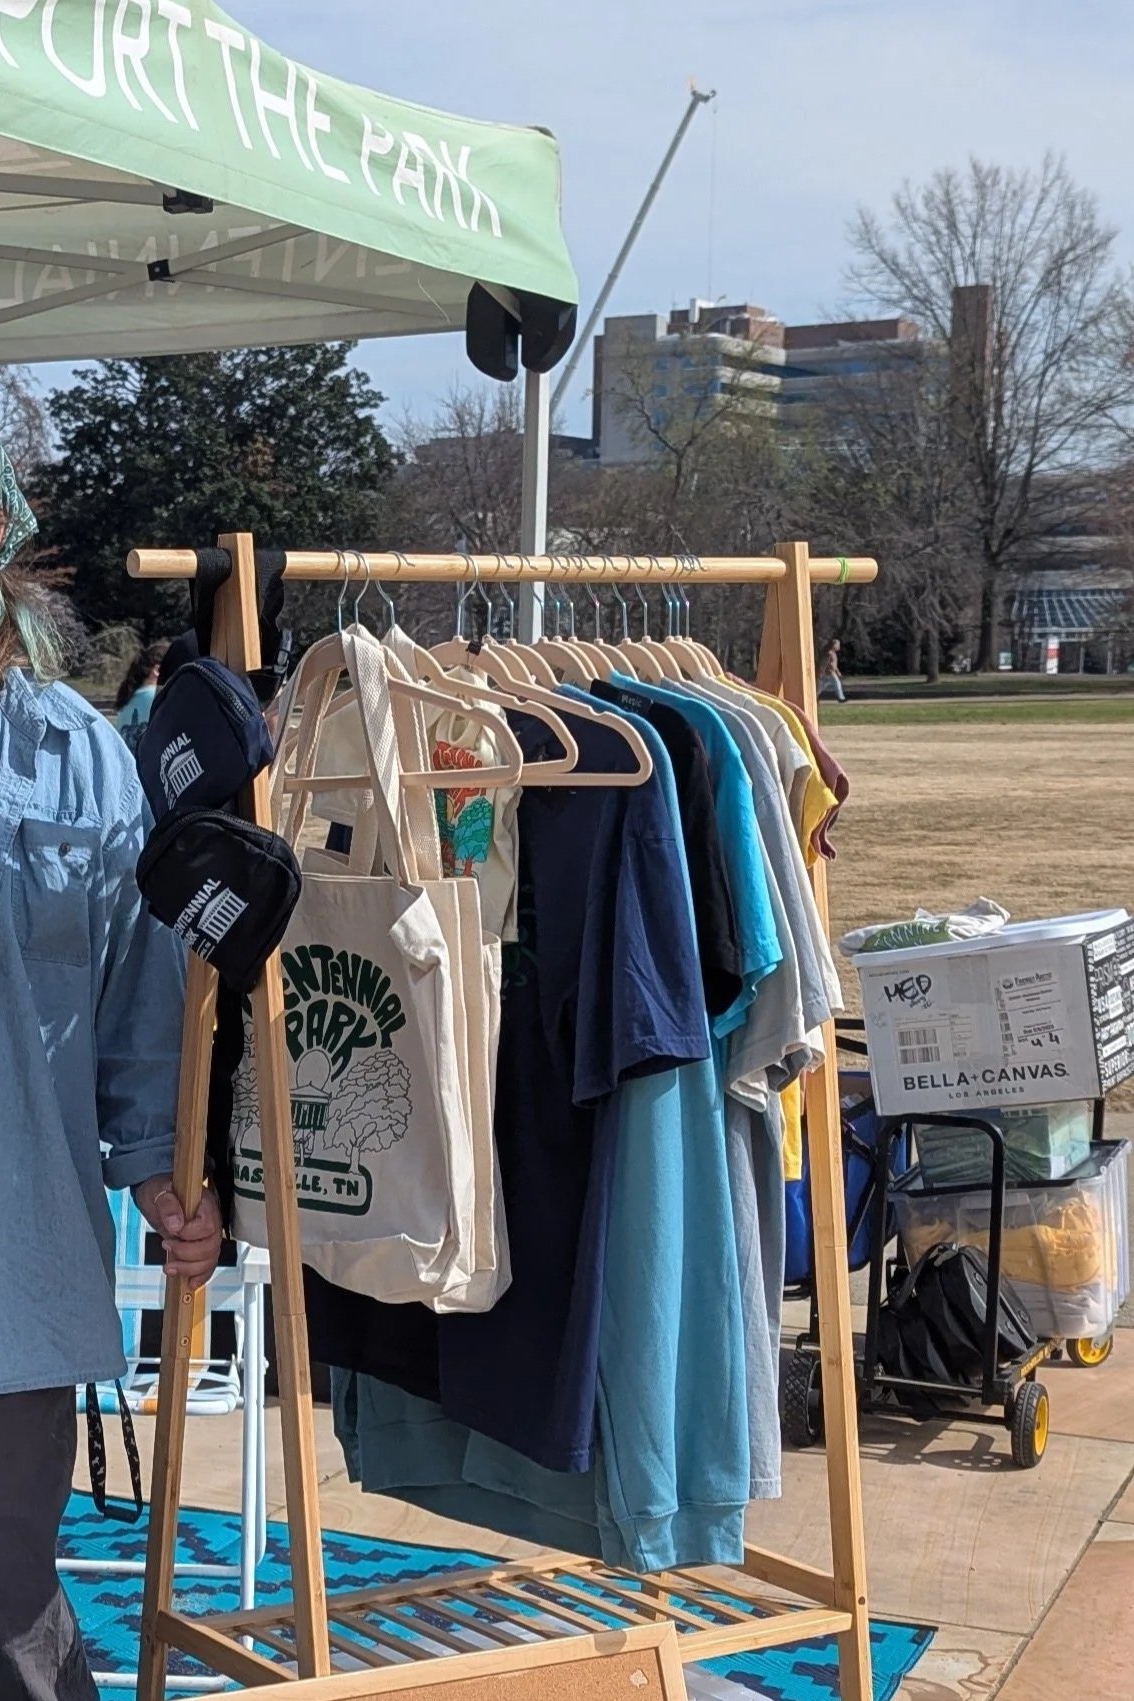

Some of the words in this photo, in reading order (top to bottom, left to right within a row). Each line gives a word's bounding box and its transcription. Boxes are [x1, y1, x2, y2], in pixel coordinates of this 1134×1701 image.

[205, 18, 351, 184] THE
[884, 974, 932, 1003] MED
[285, 999, 378, 1082] PARK
[949, 1091, 969, 1099] LOS
[976, 1087, 1025, 1097] ANGELES
[333, 1177, 359, 1196] TN
